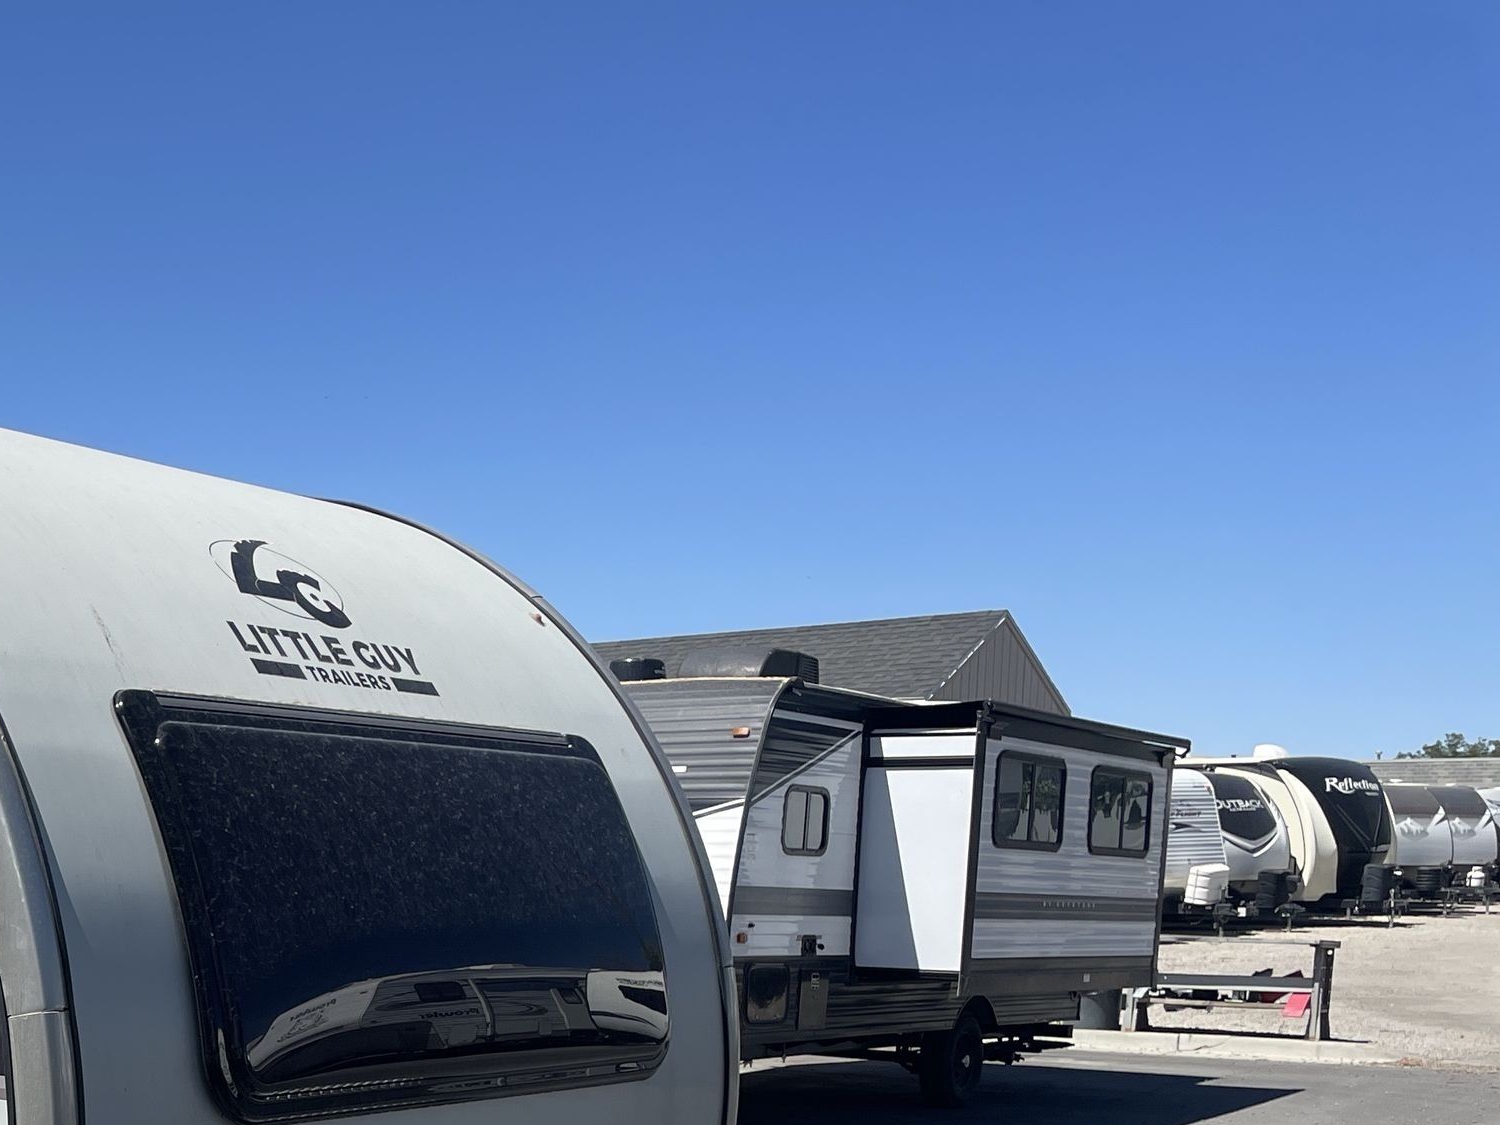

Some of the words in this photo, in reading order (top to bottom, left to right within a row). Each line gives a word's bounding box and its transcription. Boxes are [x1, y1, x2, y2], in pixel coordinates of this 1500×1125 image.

[226, 620, 355, 667] LITTLE
[352, 640, 421, 676] GUY
[305, 665, 391, 691] TRAILERS
[1324, 777, 1380, 794] Reflection
[1215, 799, 1264, 809] OUTBACK
